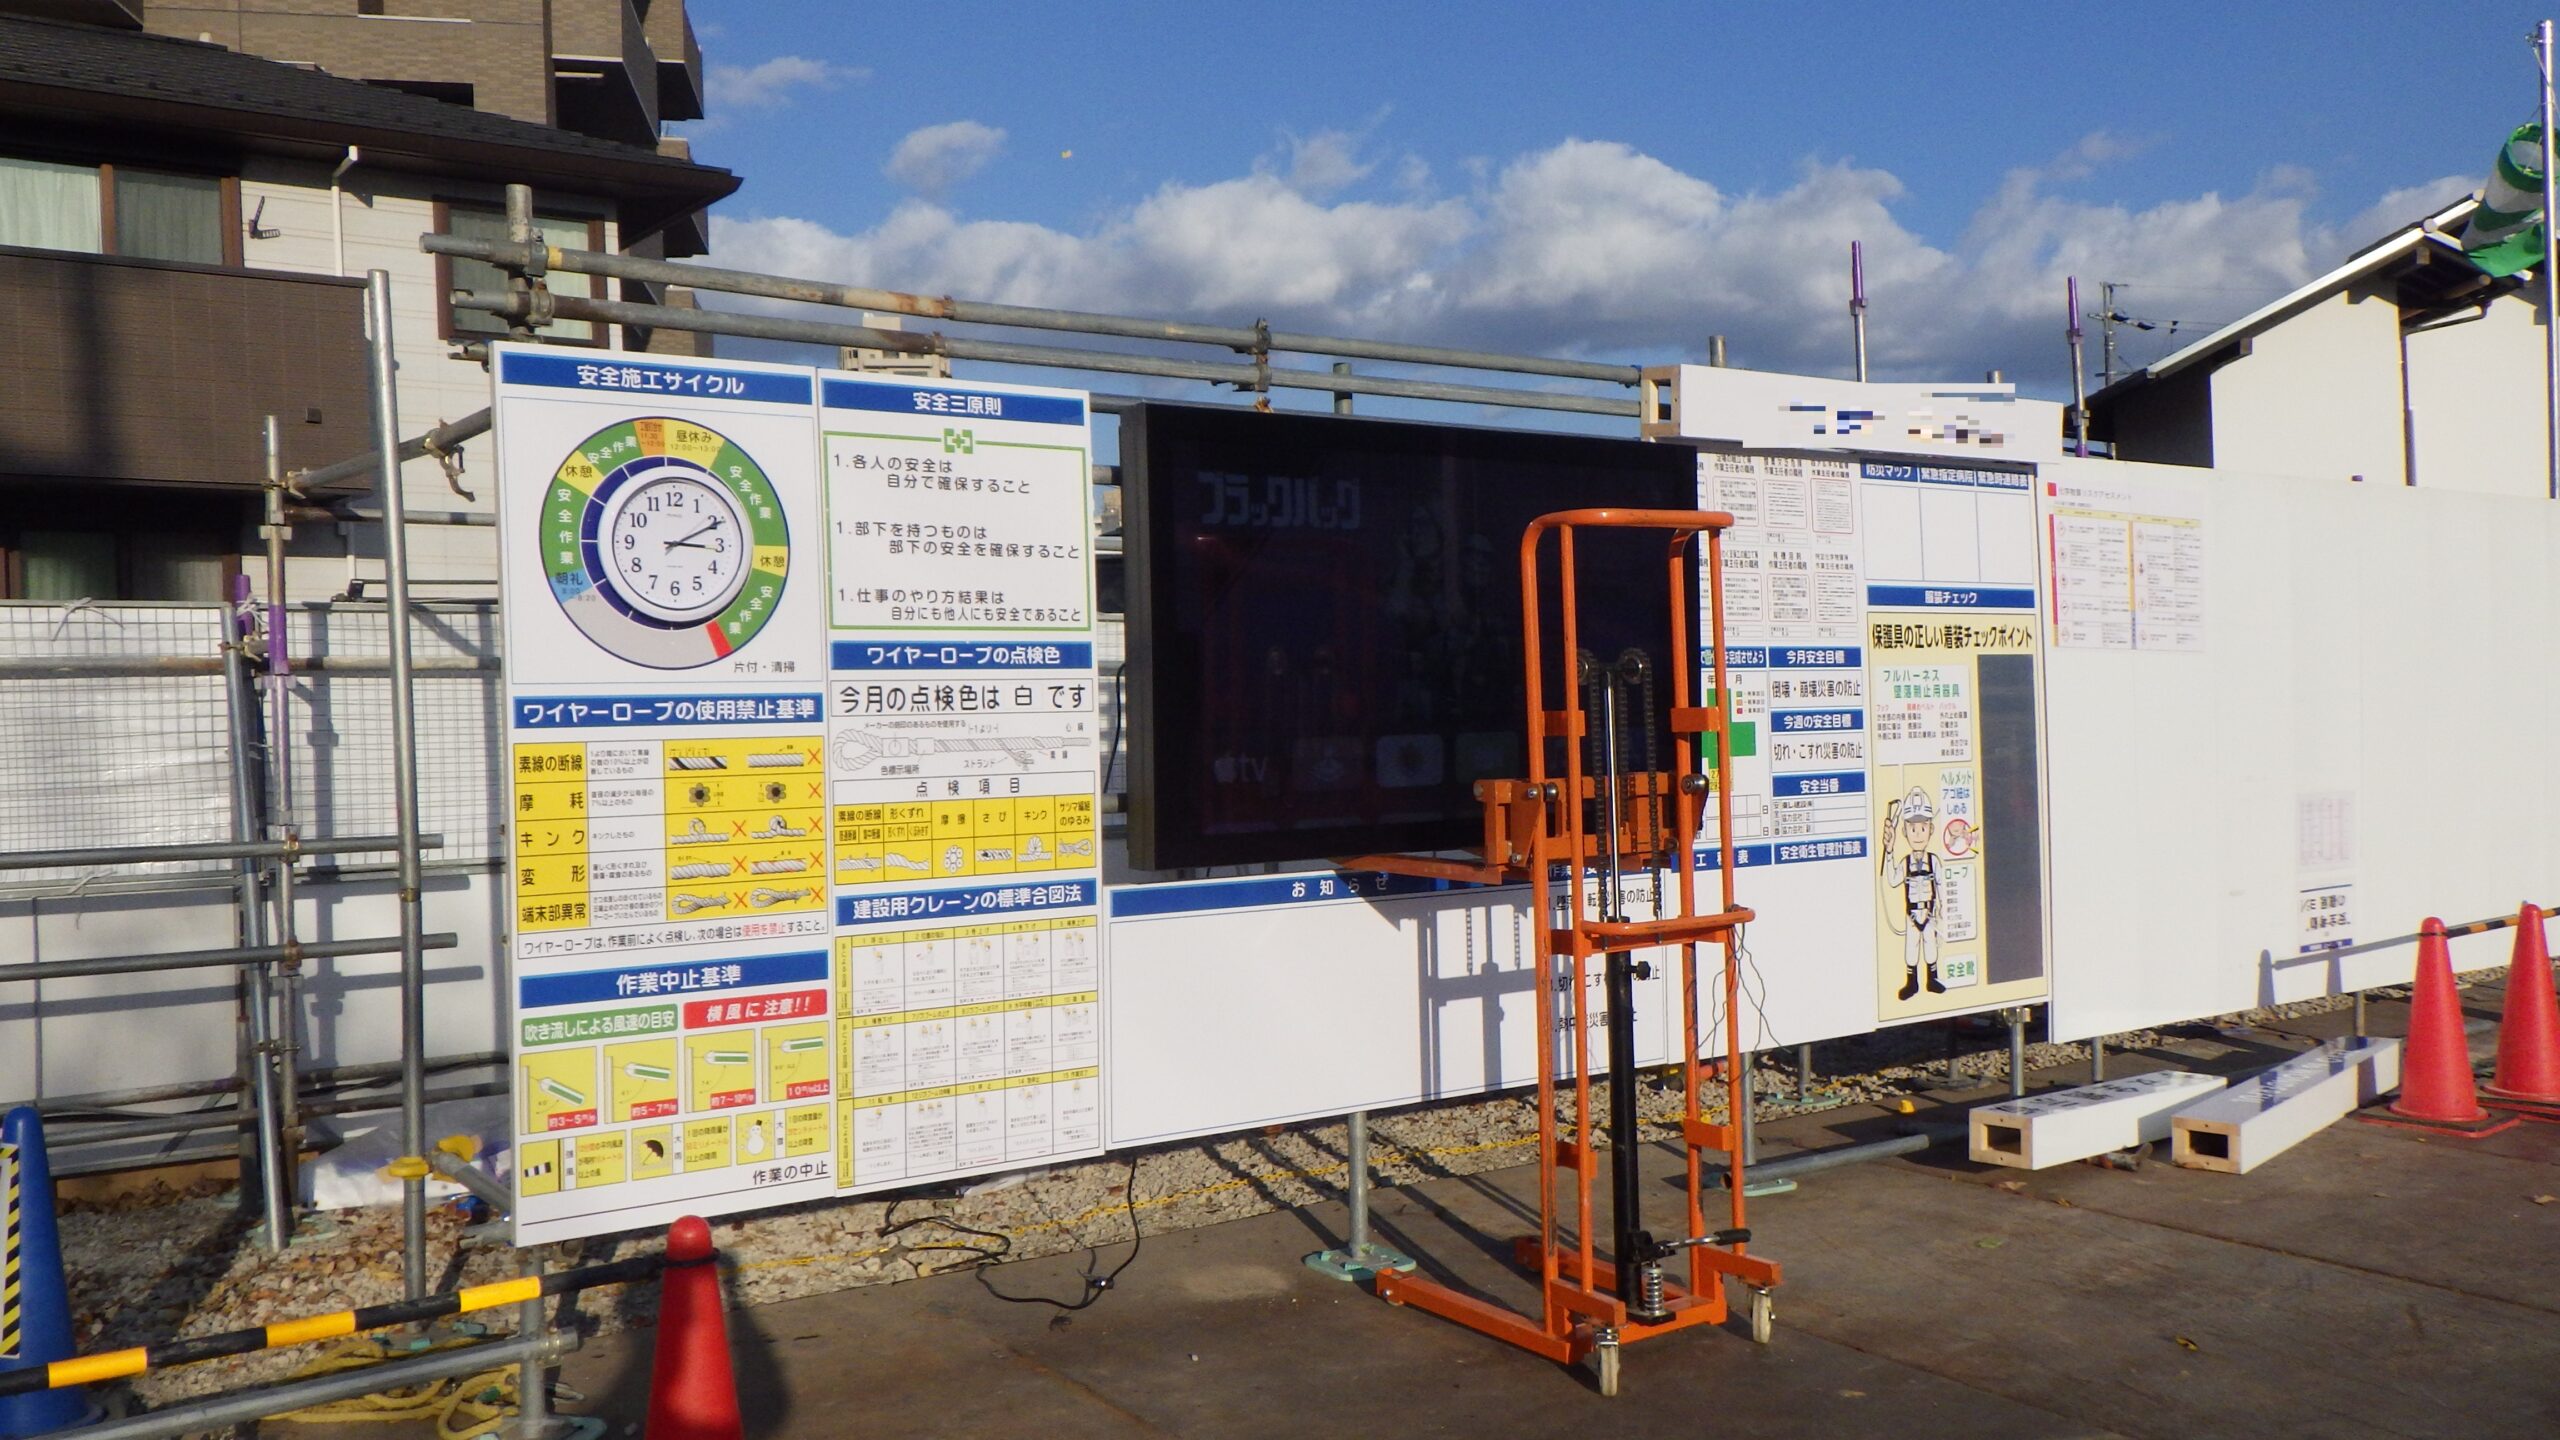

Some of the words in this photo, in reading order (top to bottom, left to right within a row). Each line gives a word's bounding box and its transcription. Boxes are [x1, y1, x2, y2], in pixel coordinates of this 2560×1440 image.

[577, 364, 745, 395] 安全施工サイクル
[913, 391, 1003, 417] 安全三原則
[676, 429, 712, 443] 昼休み
[565, 464, 593, 479] 休憩
[1866, 465, 1911, 478] 防災マップ
[887, 474, 1031, 494] 自分で確保すること
[647, 496, 660, 512] 11
[665, 491, 684, 508] 12
[693, 498, 700, 514] 1
[630, 512, 648, 528] 10
[707, 515, 718, 530] 2
[624, 534, 635, 550] 9
[715, 537, 725, 553] 3
[889, 540, 1080, 560] 部下の安全を確保すること
[631, 558, 642, 574] 8
[707, 559, 718, 575] 4
[759, 554, 786, 568] 休憩
[648, 574, 659, 590] 7
[670, 580, 681, 596] 6
[692, 575, 703, 591] 5
[1925, 590, 1977, 604] 服装チェック
[891, 606, 1082, 622] 自分にも他人にも安全であること
[1872, 624, 2032, 649] 保護具の正しい着装チェックポイント
[867, 645, 1061, 665] ワイヤーロープの点検色
[1786, 650, 1845, 664] 今月安全目標
[1883, 670, 1940, 682] フルハーネス
[1772, 680, 1861, 698] 倒壊・崩壊災害の防止
[839, 685, 1000, 713] 今月の点検色は
[1015, 686, 1033, 706] 白
[1047, 684, 1086, 709] です
[522, 699, 816, 724] ワイヤーロープの使用禁止基準
[1774, 743, 1863, 761] 切れ・こすれ災害の防止
[519, 753, 583, 773] 素線の断線
[1800, 778, 1840, 793] 安全当番
[1941, 772, 1973, 787] ヘルメット
[1024, 810, 1048, 821] キンク
[1947, 803, 1967, 815] しめる
[1945, 866, 1968, 880] ロープ
[1292, 877, 1389, 897] お知らせ
[853, 885, 1082, 920] 建設用クレーンの標準合図法
[522, 903, 587, 923] 端末部異常
[616, 964, 741, 995] 作業中止基準
[524, 1013, 675, 1041] 吹き流しによる風速の目安
[753, 1161, 829, 1185] 作業の中止
